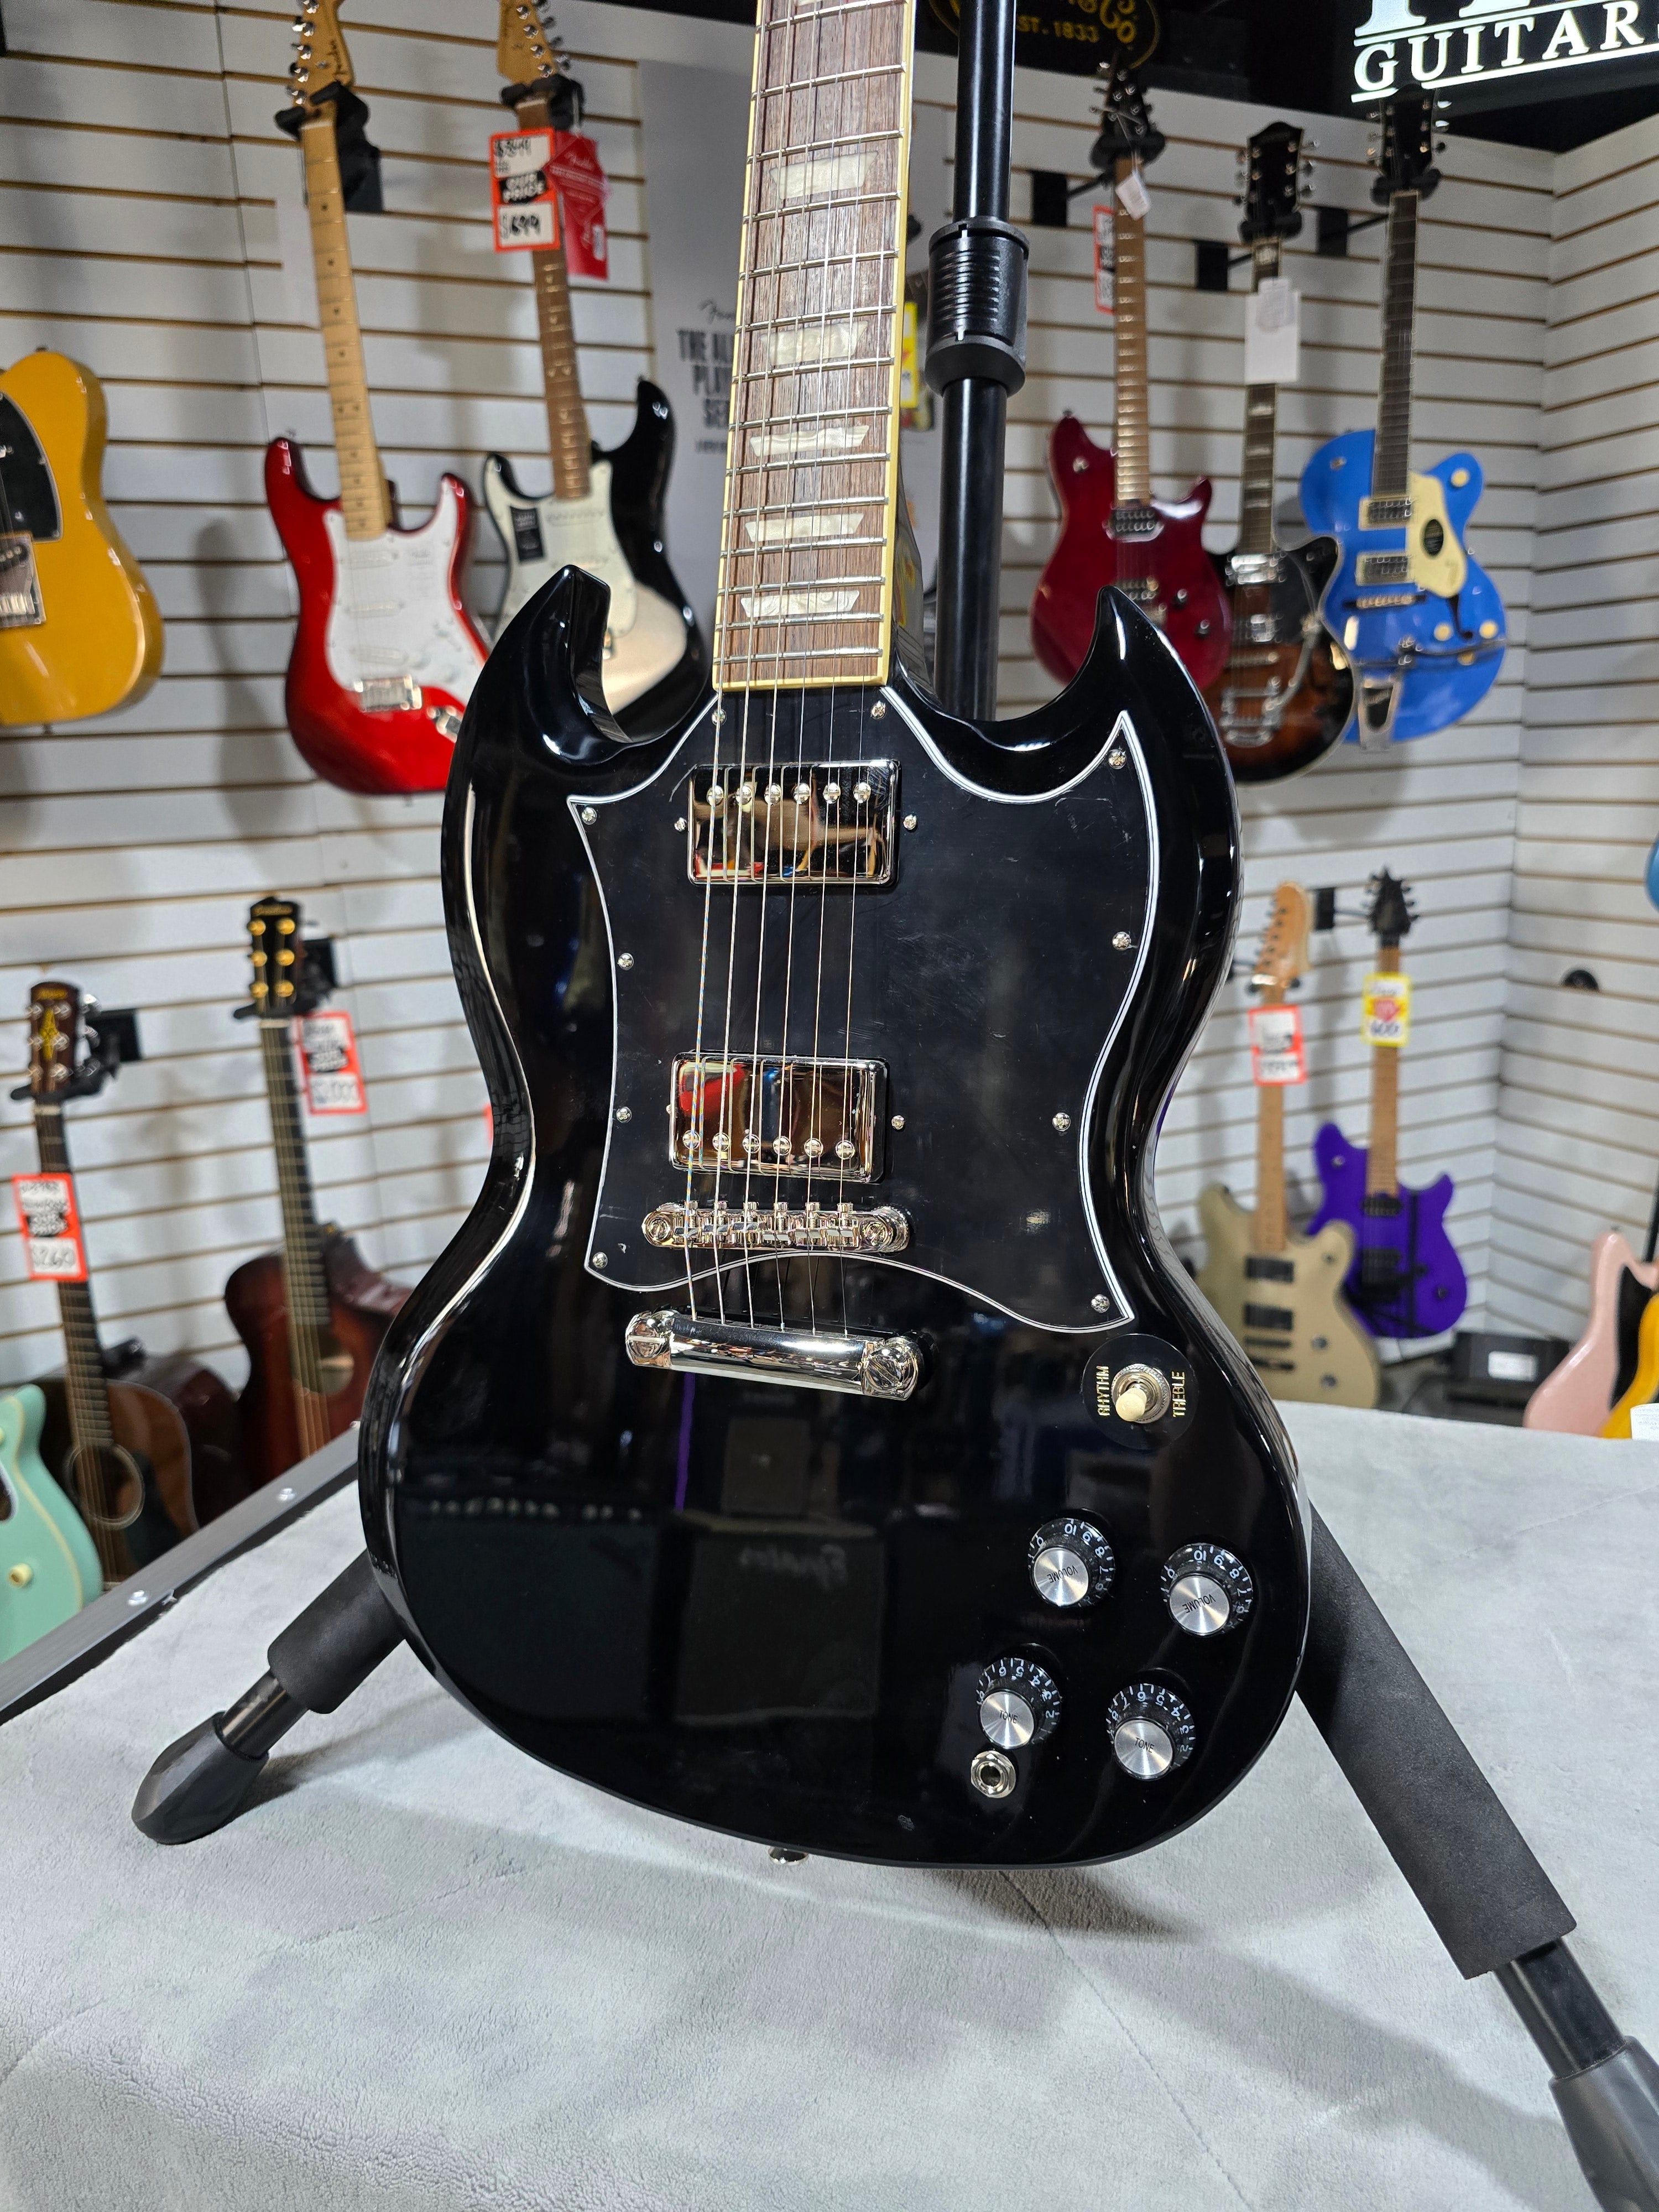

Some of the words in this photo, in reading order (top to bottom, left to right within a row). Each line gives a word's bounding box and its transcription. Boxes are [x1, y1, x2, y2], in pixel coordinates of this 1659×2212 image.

[1016, 14, 1049, 35] ST.
[1053, 20, 1099, 43] 1833
[1353, 0, 1659, 92] GUITAR
[1096, 1365, 1110, 1416] RHYTHM
[1171, 1371, 1187, 1417] TREBLE
[1065, 1523, 1077, 1535] 10
[1095, 1546, 1105, 1558] 8
[1194, 1550, 1206, 1561] 10
[1047, 1565, 1078, 1583] VOLUME
[1229, 1568, 1240, 1579] 8
[1182, 1594, 1216, 1614] VOLUME
[1016, 1666, 1024, 1677] 5
[1032, 1675, 1041, 1685] 4
[1041, 1689, 1052, 1702] 3
[1155, 1694, 1165, 1706] 5
[999, 1710, 1018, 1724] TONE
[1045, 1710, 1055, 1718] 2
[1171, 1707, 1180, 1717] 4
[1180, 1725, 1189, 1735] 3
[1134, 1737, 1156, 1754] TONE
[1180, 1744, 1189, 1752] 2
